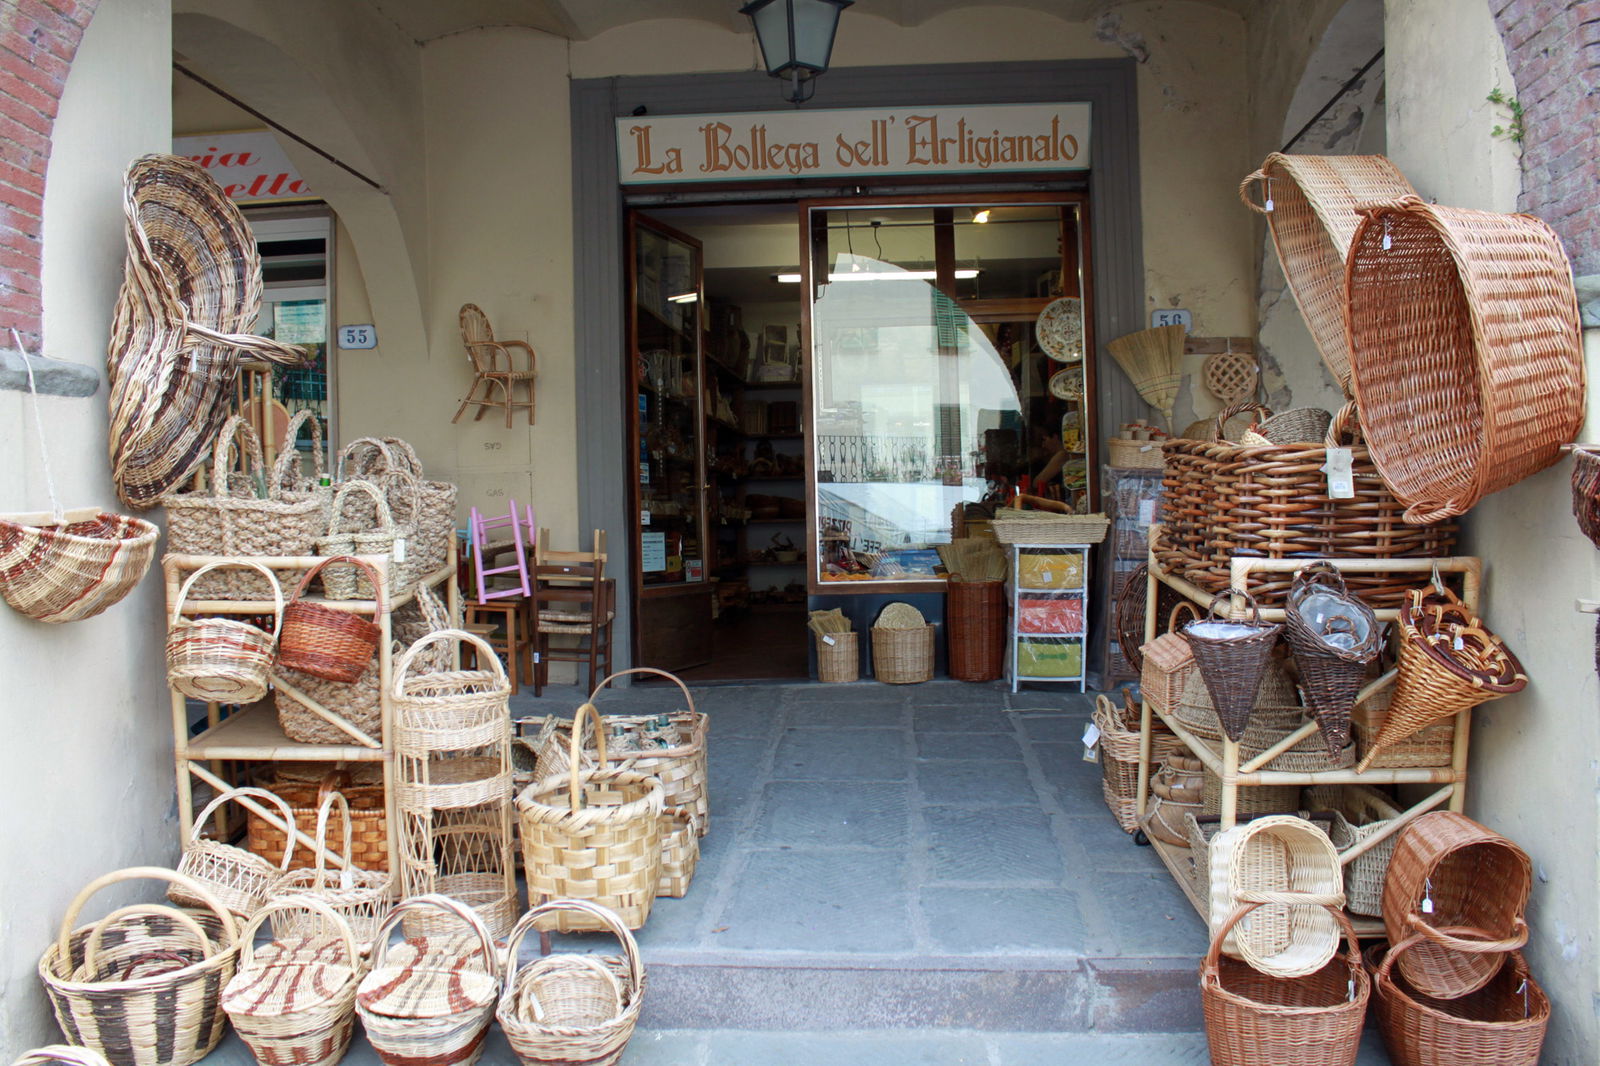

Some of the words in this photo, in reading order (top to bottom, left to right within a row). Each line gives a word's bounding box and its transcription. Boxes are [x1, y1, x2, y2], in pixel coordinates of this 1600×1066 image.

[630, 125, 684, 175] La
[698, 121, 821, 175] Bottega
[346, 329, 368, 344] 55
[486, 489, 504, 498] GAS
